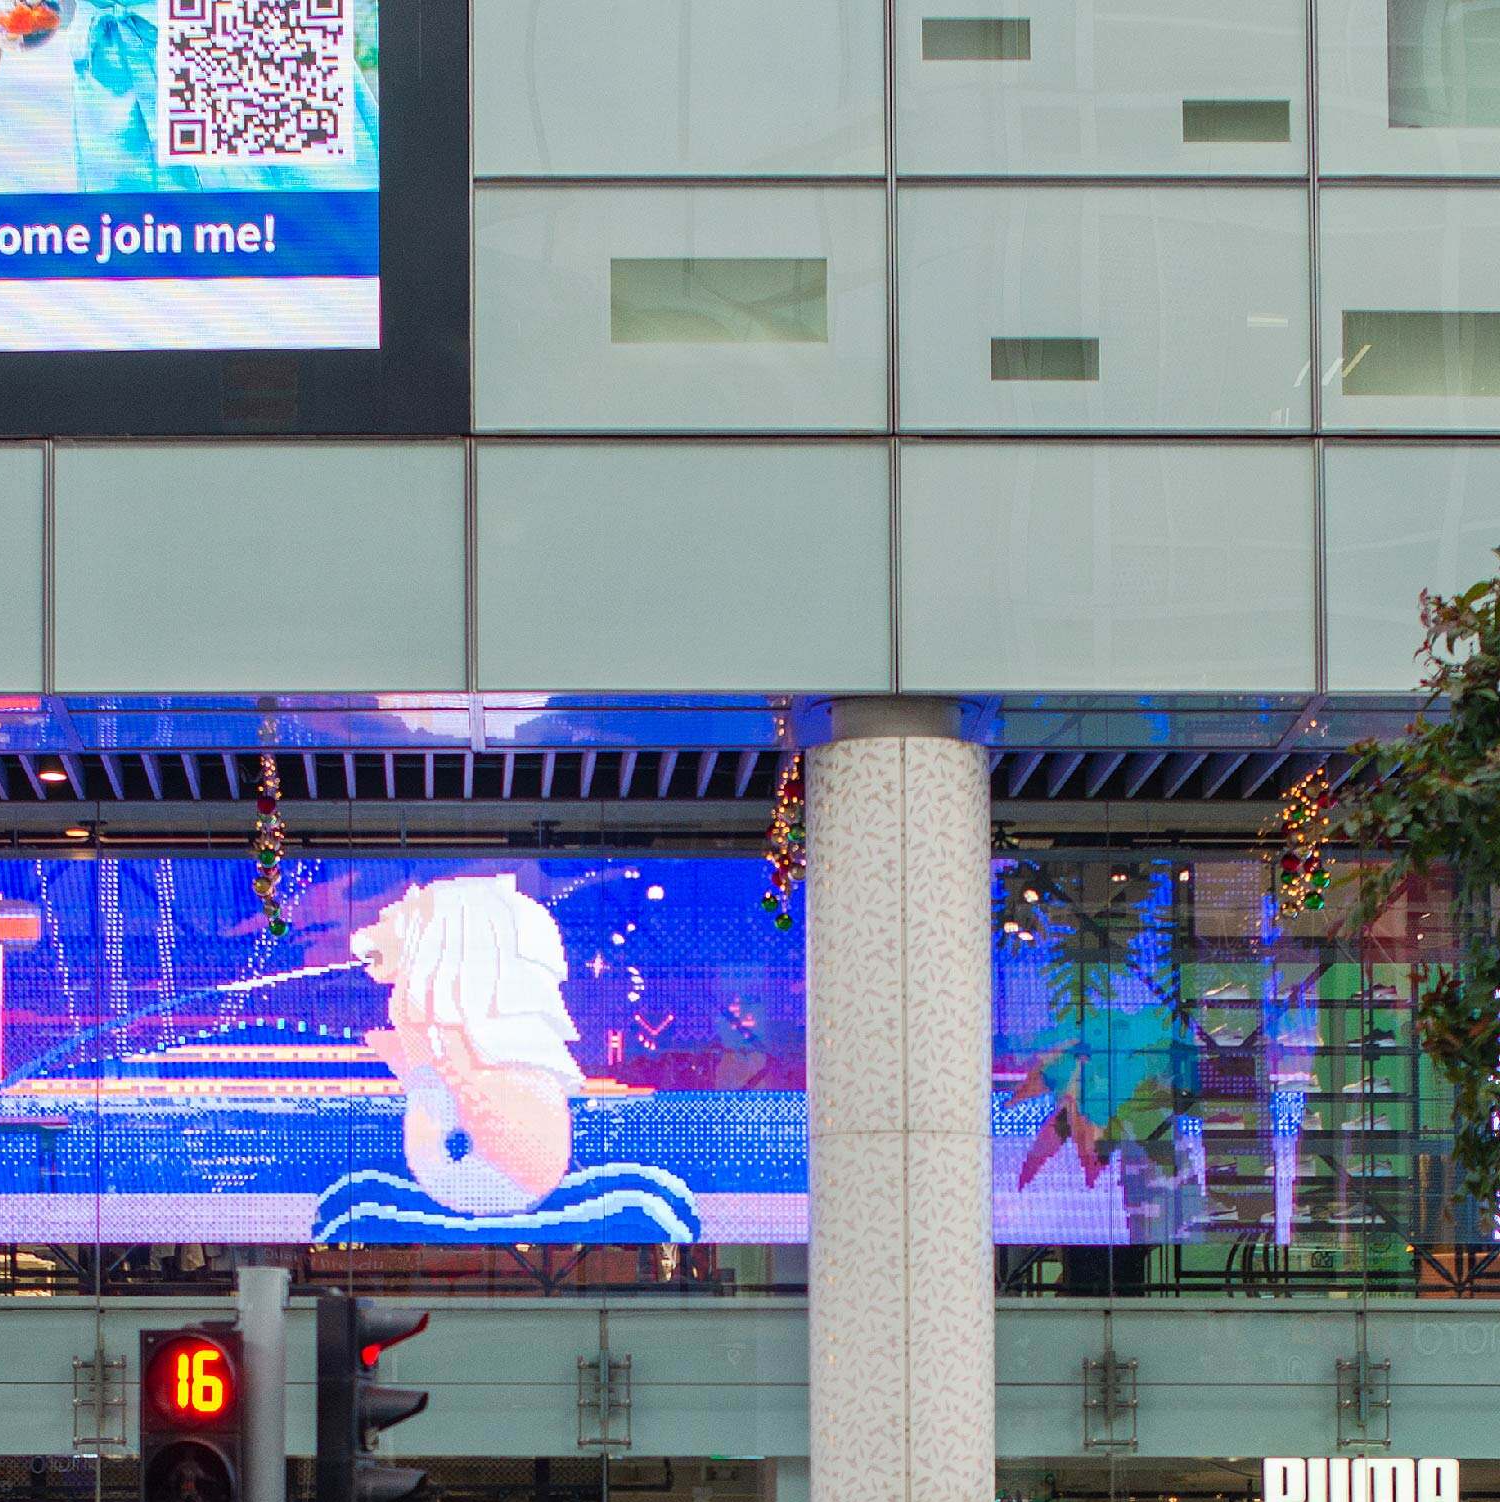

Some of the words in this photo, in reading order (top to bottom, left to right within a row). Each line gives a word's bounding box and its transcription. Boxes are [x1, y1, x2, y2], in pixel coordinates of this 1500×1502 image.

[95, 213, 183, 263] join
[194, 213, 277, 254] me!
[177, 1349, 223, 1412] 16
